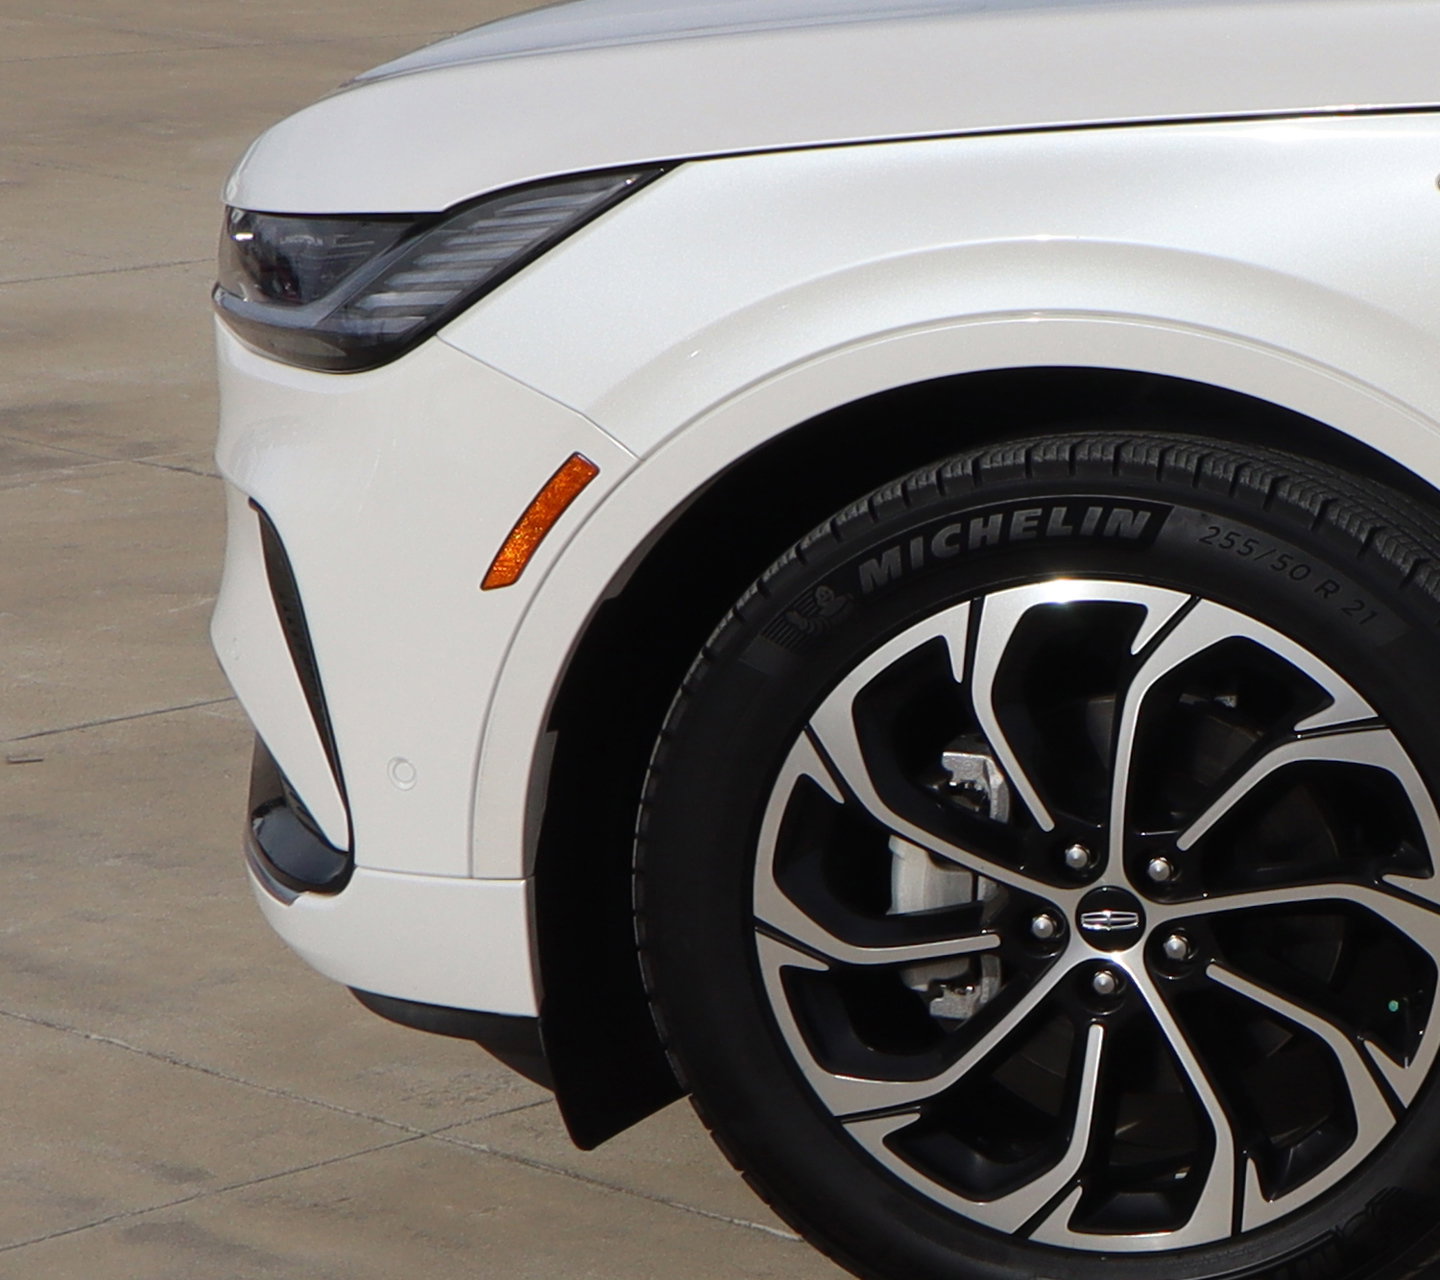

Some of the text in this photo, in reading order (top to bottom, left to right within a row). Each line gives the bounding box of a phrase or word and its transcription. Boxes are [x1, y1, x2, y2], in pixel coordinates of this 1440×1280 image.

[858, 505, 1152, 595] MICHELIN
[1199, 525, 1379, 625] 255/50 R 21
